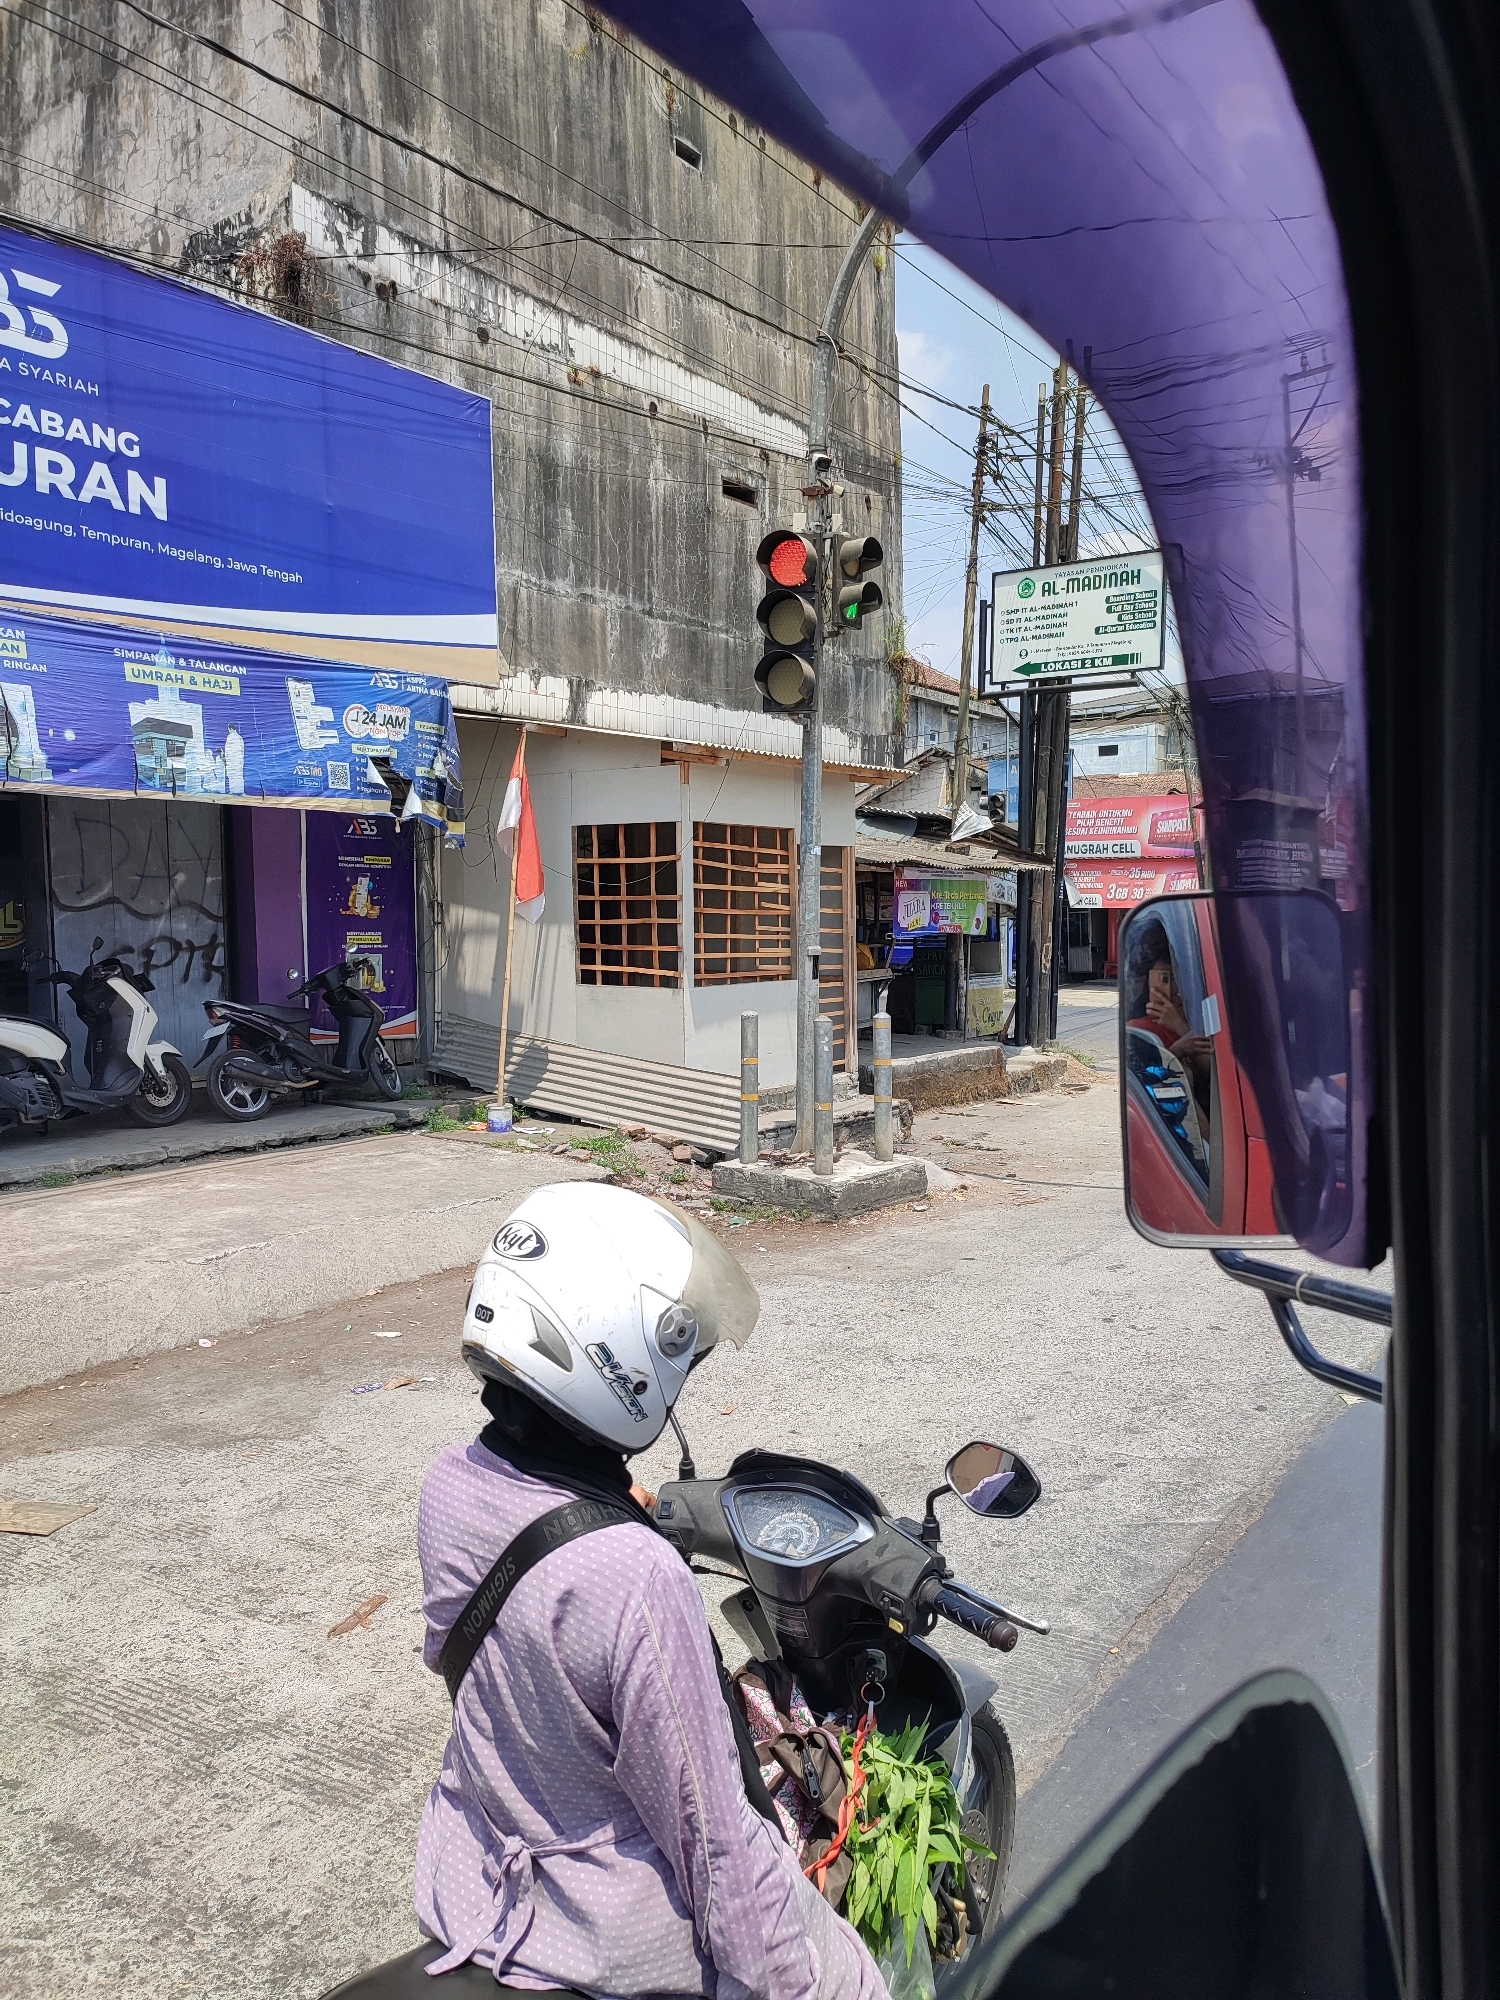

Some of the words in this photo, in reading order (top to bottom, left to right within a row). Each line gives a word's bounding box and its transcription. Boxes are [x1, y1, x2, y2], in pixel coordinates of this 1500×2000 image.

[18, 362, 99, 396] SYARIAH
[79, 525, 155, 554] Tempuran,
[158, 542, 225, 569] Magelang,
[227, 557, 258, 574] Jawa
[260, 564, 303, 584] Tengah
[1054, 568, 1085, 579] YAYASAN
[1085, 563, 1129, 574] PENDIDIKAN
[1041, 568, 1141, 598] AL-MADINAH
[1109, 593, 1134, 603] Boarding
[1134, 590, 1155, 600] School
[1005, 608, 1020, 616] SMP
[1028, 602, 1074, 613] AL-MADINAH
[1111, 604, 1122, 612] Full
[1122, 604, 1134, 612] Day
[1134, 600, 1155, 610] School
[1023, 612, 1068, 623] AL-MADINAH
[1134, 611, 1154, 619] School
[1023, 621, 1068, 633] AL-MADINAH
[1125, 621, 1154, 631] Education
[1019, 631, 1065, 643] AL-MADINAH
[3, 659, 48, 673] RINGAN
[113, 647, 176, 665] SIMPANAN
[178, 656, 187, 667] &
[188, 658, 247, 676] TALANGAN
[1041, 659, 1082, 672] LOKASI
[1084, 659, 1093, 668] 2
[1094, 656, 1113, 667] KM
[131, 667, 185, 685] UMRAH
[188, 675, 198, 686] &
[202, 678, 233, 691] HAJI
[406, 676, 427, 686] KSPPS
[406, 685, 429, 695] ARTHA
[362, 710, 377, 726] 24
[379, 713, 407, 730] JAM
[369, 727, 387, 736] NON
[1068, 810, 1098, 820] TERBAIK
[1098, 808, 1133, 818] UNTUKMU
[1076, 819, 1095, 828] PILIH
[1095, 817, 1126, 827] BENEFIT
[1064, 843, 1109, 855] NUGRAH
[1111, 842, 1136, 855] CELL
[1116, 888, 1129, 900] GB
[476, 1307, 493, 1321] DOT
[462, 1556, 517, 1642] SIGHMON
